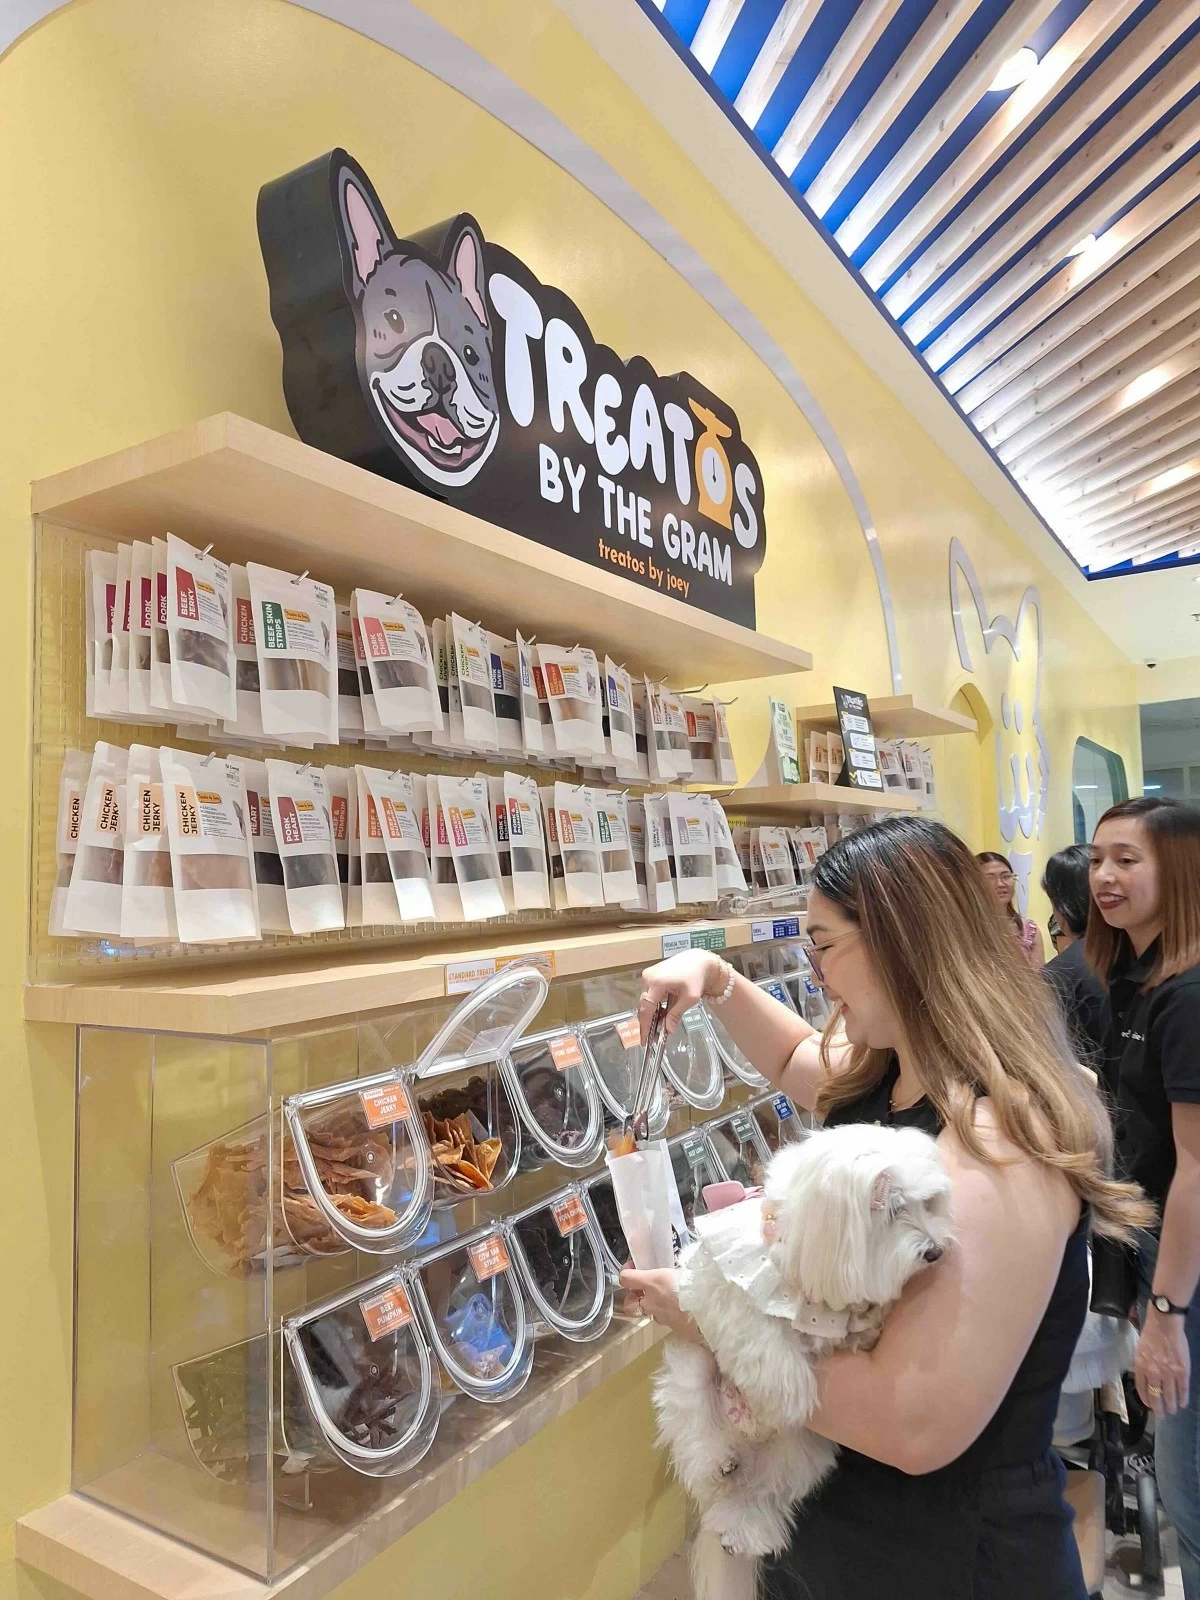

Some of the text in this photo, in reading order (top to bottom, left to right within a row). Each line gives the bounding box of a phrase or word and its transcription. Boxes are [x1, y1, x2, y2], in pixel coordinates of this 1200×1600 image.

[489, 273, 758, 549] TREATOS
[538, 443, 733, 585] BY THE GRAM
[598, 538, 690, 598] treatos by joey
[180, 591, 188, 616] BEEF
[188, 588, 196, 618] JERKY
[267, 623, 275, 648] BEEF
[275, 618, 284, 649] STRIPS
[371, 633, 380, 656] PORK
[377, 632, 387, 655] CHIPS
[458, 643, 466, 675] CHICKEN
[70, 798, 80, 839] CHICKEN
[100, 789, 114, 830] CHICKEN
[110, 802, 120, 831] JERKY
[143, 790, 151, 832] CHICKEN
[152, 802, 161, 832] JERKY
[179, 792, 189, 834] CHICKEN
[189, 804, 198, 835] JERKY
[338, 801, 346, 838] PUMPKIN
[283, 816, 292, 842] PORK
[291, 812, 300, 841] HEART
[453, 814, 462, 845] CHICKEN
[561, 814, 569, 843] CHICKEN
[448, 970, 476, 981] STANDARD
[476, 967, 495, 977] TREATS
[373, 1095, 398, 1107] CHICKEN
[380, 1103, 397, 1114] JERKY
[478, 1251, 490, 1261] COW
[484, 1256, 500, 1268] STRIPS
[377, 1307, 402, 1326] PUMPKIN
[380, 1301, 394, 1313] BEEF
